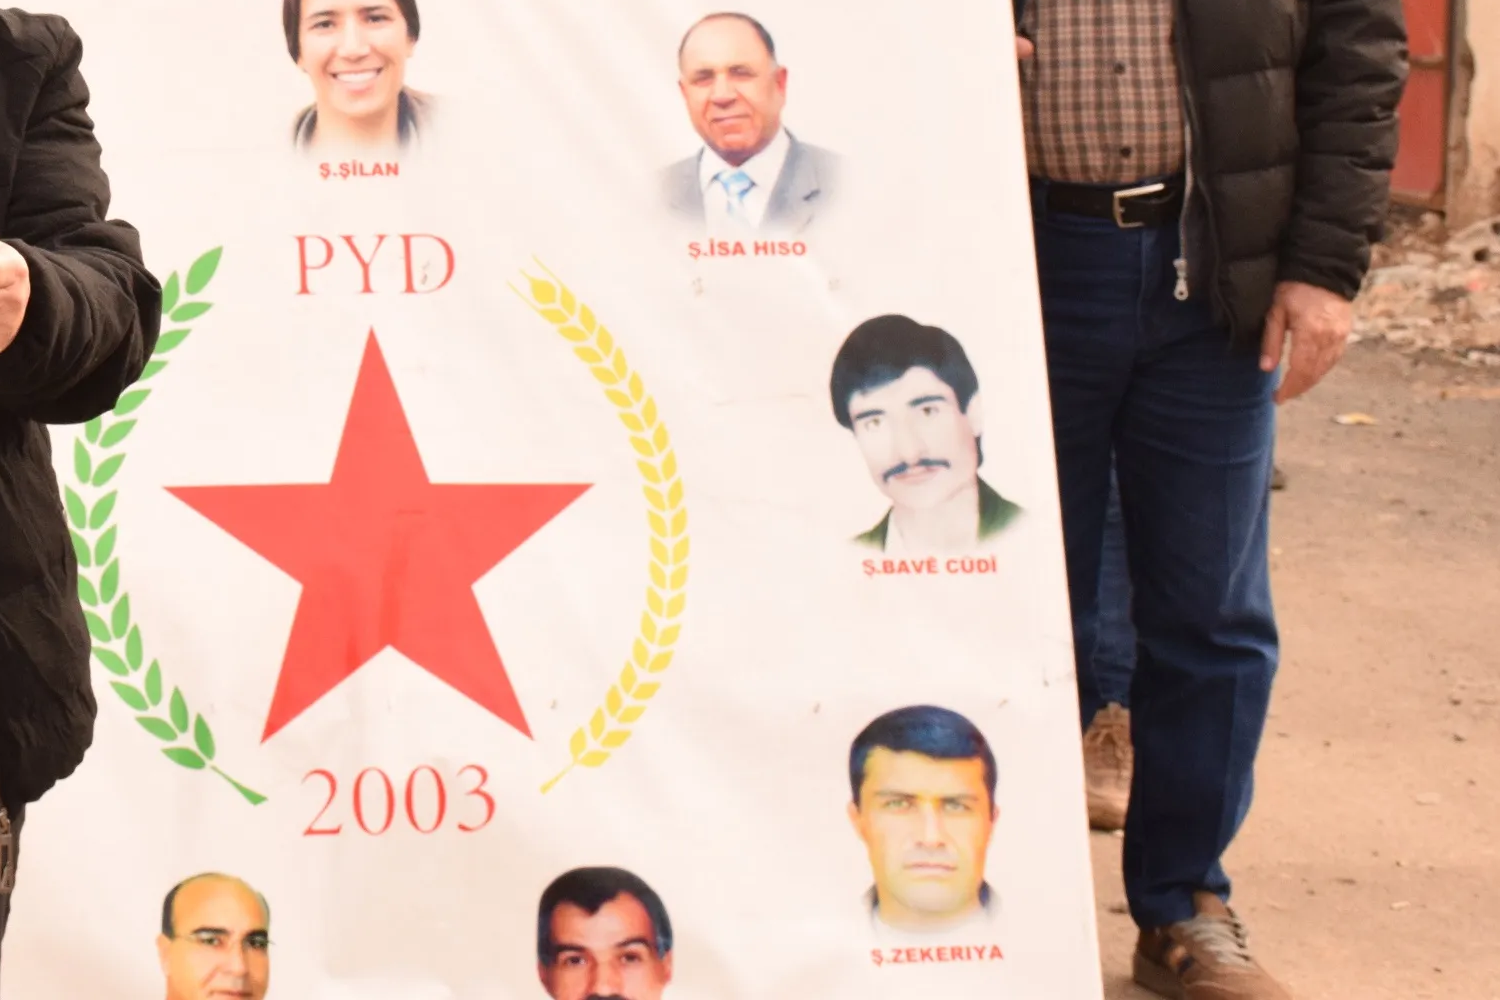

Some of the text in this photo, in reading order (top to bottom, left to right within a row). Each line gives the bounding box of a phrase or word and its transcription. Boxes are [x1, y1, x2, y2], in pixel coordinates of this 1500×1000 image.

[293, 233, 456, 295] PYD
[753, 241, 807, 257] HISO
[300, 763, 496, 836] 2003
